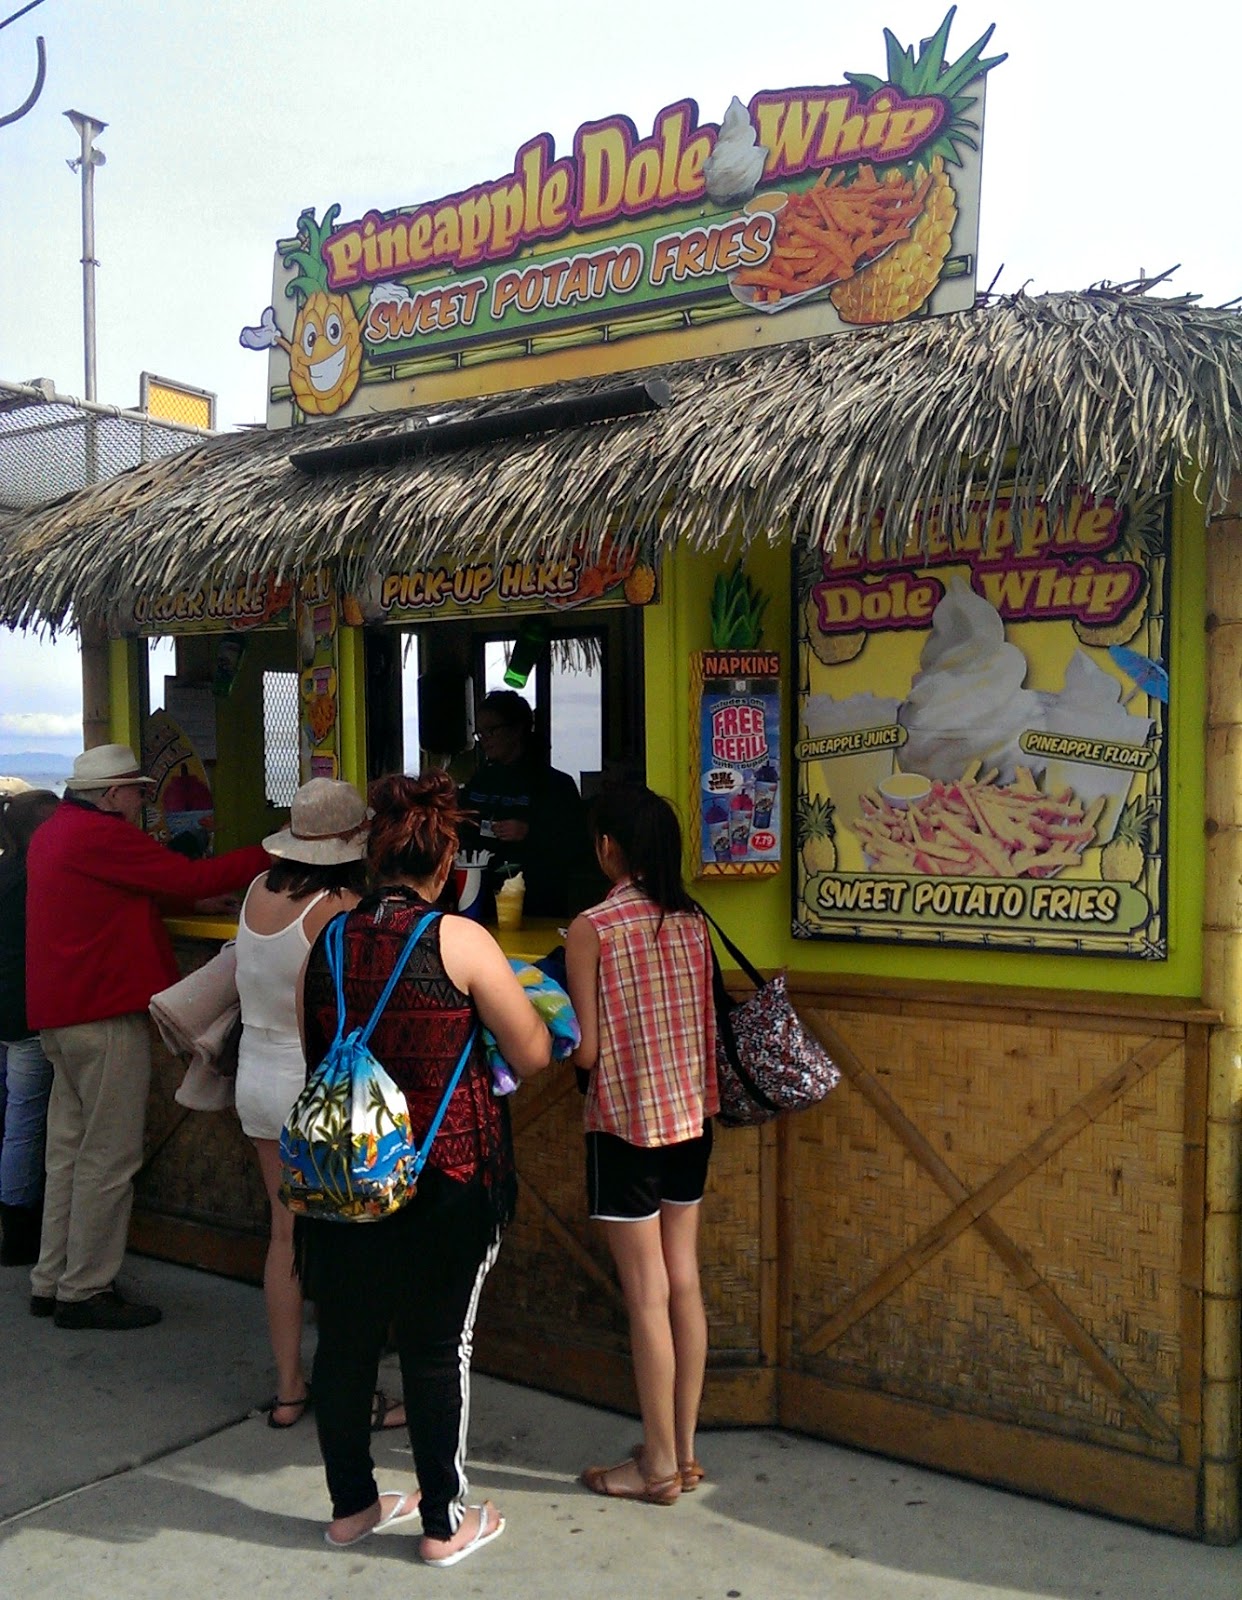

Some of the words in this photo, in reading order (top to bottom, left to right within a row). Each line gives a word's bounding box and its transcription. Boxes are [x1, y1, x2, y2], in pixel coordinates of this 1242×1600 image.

[330, 144, 570, 281] Pineapple
[581, 114, 711, 209] Dole
[752, 95, 937, 173] Whip
[367, 284, 482, 343] SWEET
[493, 246, 643, 317] POTATO
[651, 213, 776, 282] FRIES
[382, 566, 494, 608] PICK-UP
[499, 557, 582, 598] HERE
[821, 580, 932, 623] Dole
[980, 566, 1134, 615] Whip
[705, 656, 779, 675] NAPKINS
[713, 706, 765, 737] FREE
[713, 735, 768, 762] REFILL
[801, 733, 862, 757] PINEAPPLE
[864, 728, 899, 746] JUICE
[1027, 734, 1101, 760] PINEAPPLE
[1105, 745, 1151, 766] FLOAT
[754, 835, 773, 847] 7.79
[818, 879, 907, 912] SWEET
[914, 885, 1022, 917] POTATO
[1031, 890, 1118, 922] FRIES
